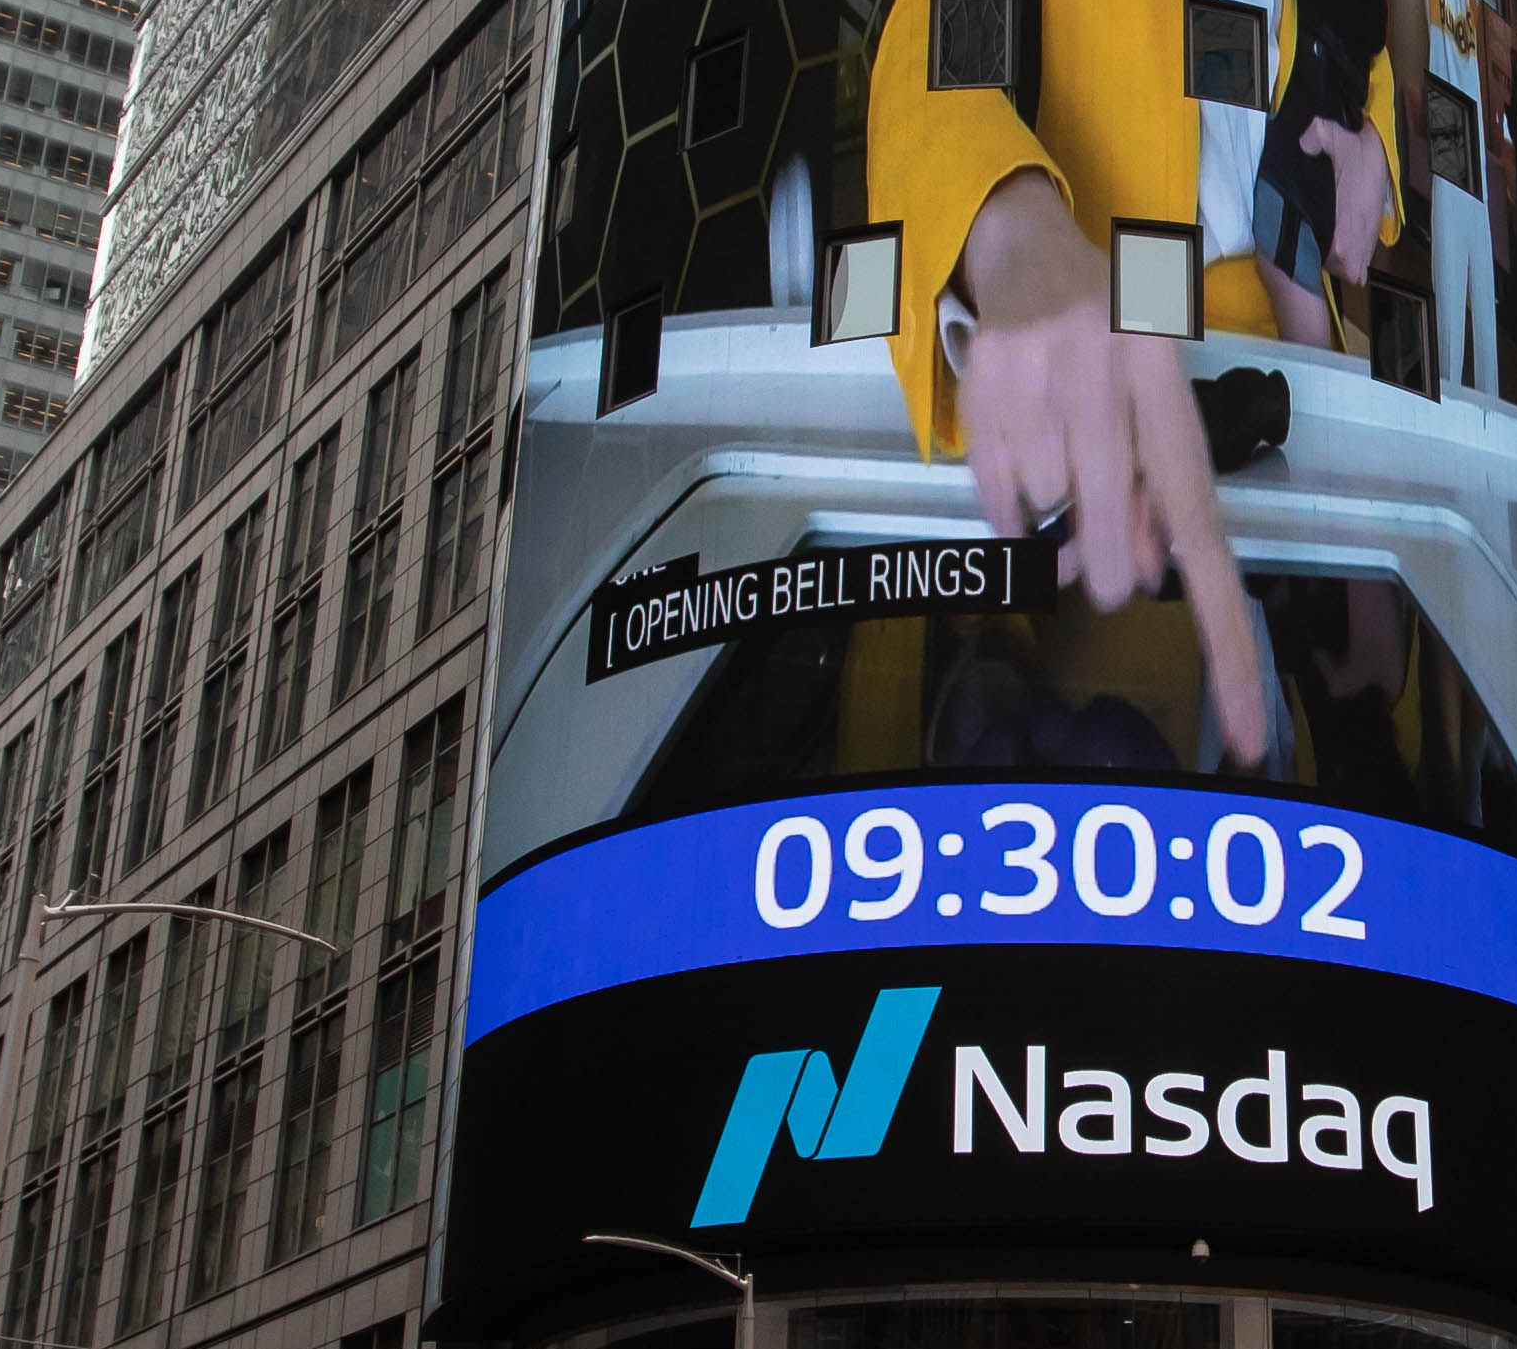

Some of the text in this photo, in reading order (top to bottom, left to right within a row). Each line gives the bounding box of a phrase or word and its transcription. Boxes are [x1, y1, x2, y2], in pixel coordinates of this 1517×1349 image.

[626, 572, 759, 652] OPENING
[771, 557, 855, 617] BELL
[870, 548, 986, 602] RINGS
[753, 802, 1367, 941] 09:30:02
[952, 1044, 1434, 1213] Nasdaq
